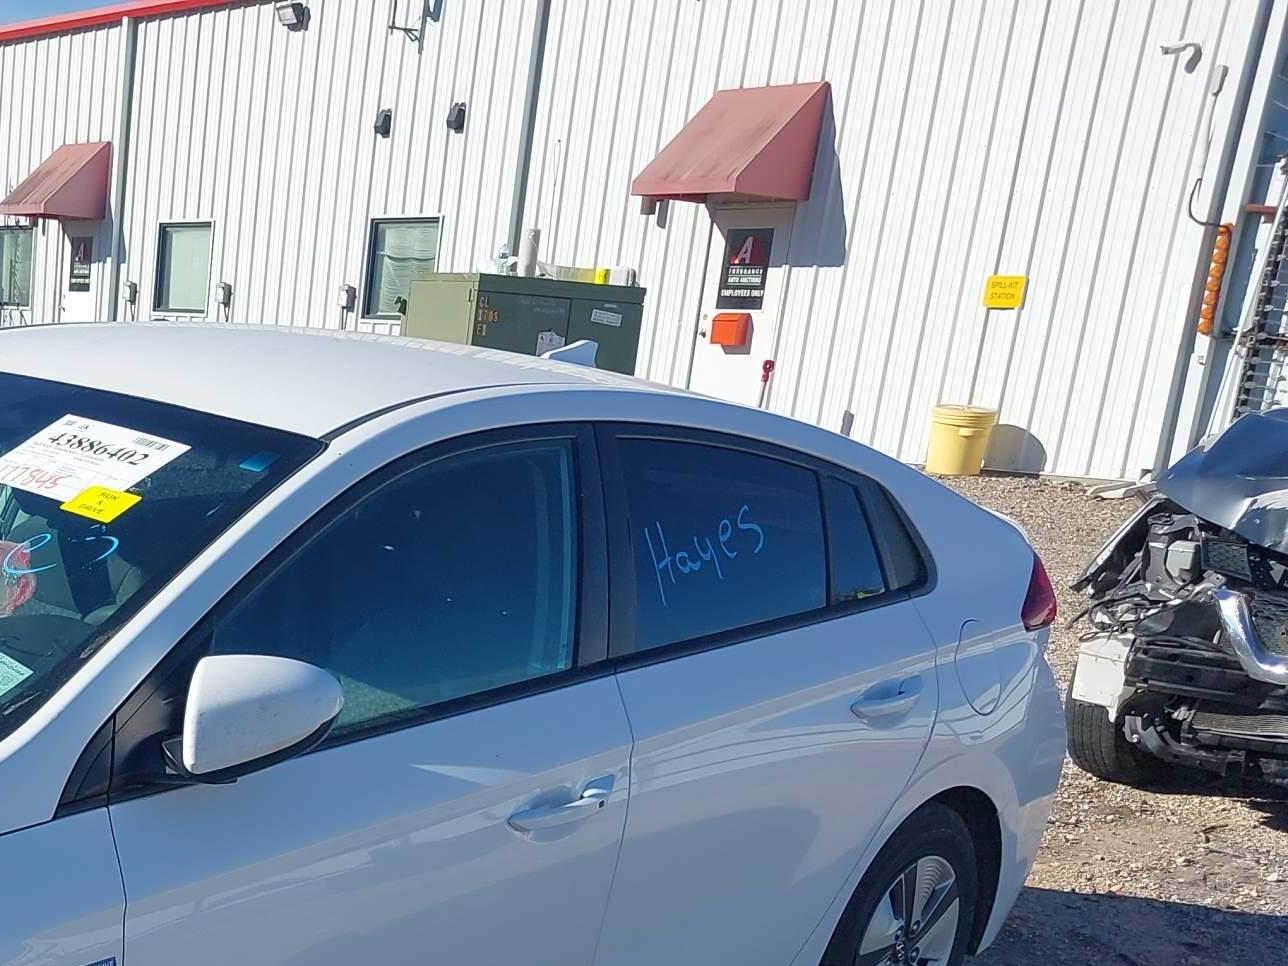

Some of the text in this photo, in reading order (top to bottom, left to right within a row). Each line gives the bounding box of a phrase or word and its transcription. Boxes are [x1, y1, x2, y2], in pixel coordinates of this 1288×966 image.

[720, 289, 764, 297] EMPLOYEES ONLY
[991, 292, 1015, 300] STATION
[48, 431, 150, 466] 43886402
[99, 490, 121, 502] RUN
[78, 502, 105, 516] DRIVE
[644, 505, 763, 607] Hayes
